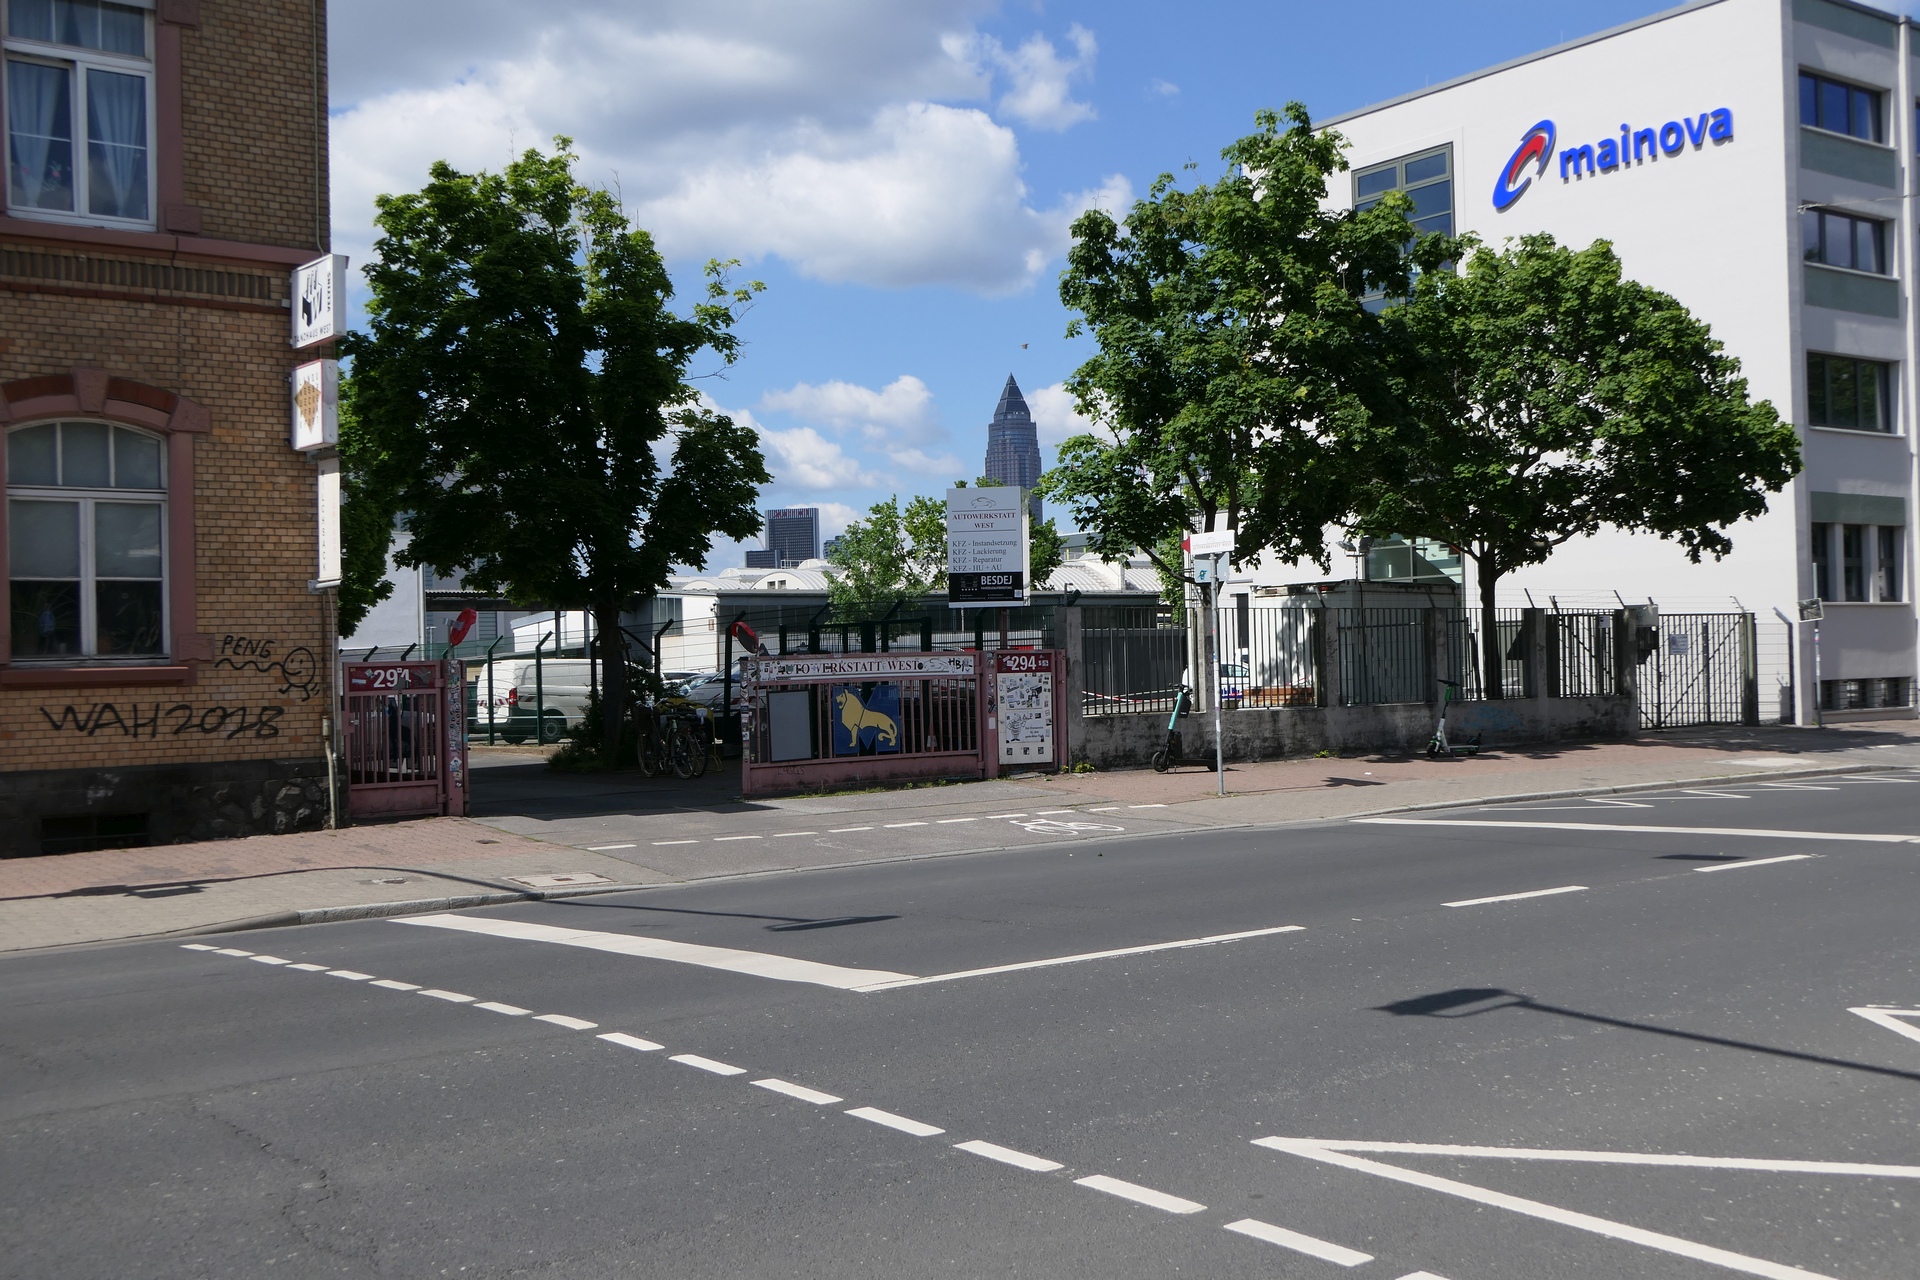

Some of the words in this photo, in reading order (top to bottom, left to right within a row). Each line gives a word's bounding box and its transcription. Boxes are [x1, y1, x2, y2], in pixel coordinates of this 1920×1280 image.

[1559, 107, 1733, 180] mainova
[953, 512, 1016, 520] AUTOWERKSTATT
[972, 548, 1007, 556] Lackierung
[972, 557, 1002, 565] Reparatur
[981, 575, 1013, 585] BESDEJ
[220, 635, 276, 659] PENG
[776, 661, 883, 676] UTOWERKSTATT
[887, 660, 919, 671] WEST
[1011, 655, 1037, 671] 294
